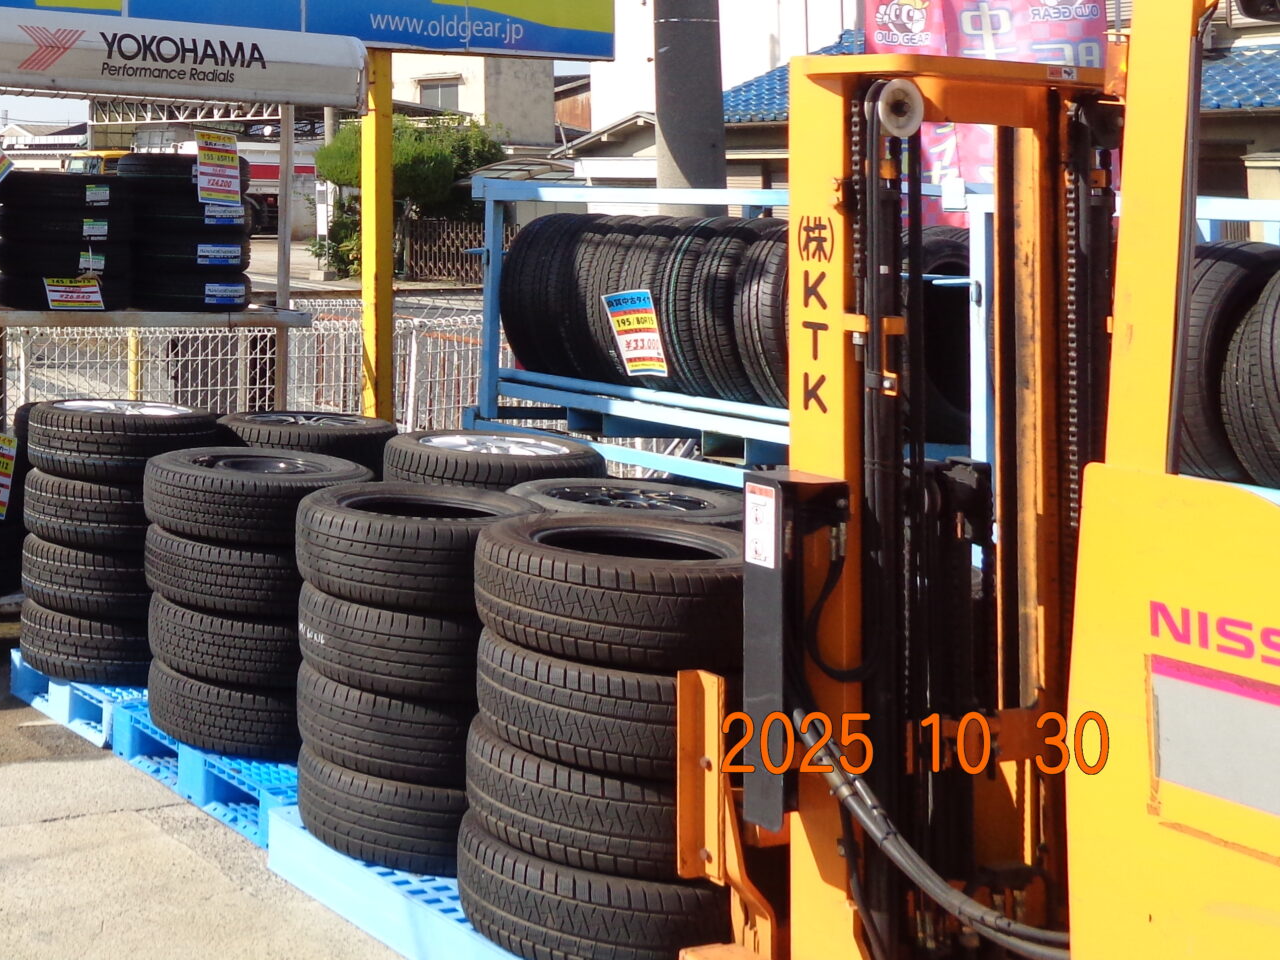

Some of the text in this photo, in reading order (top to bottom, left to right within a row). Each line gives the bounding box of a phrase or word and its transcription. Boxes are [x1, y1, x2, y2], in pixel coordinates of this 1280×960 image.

[370, 13, 524, 44] www.oldgear.jp
[876, 31, 899, 44] OLD
[99, 31, 267, 70] YOKOHAMA
[101, 62, 235, 84] Performance Radials
